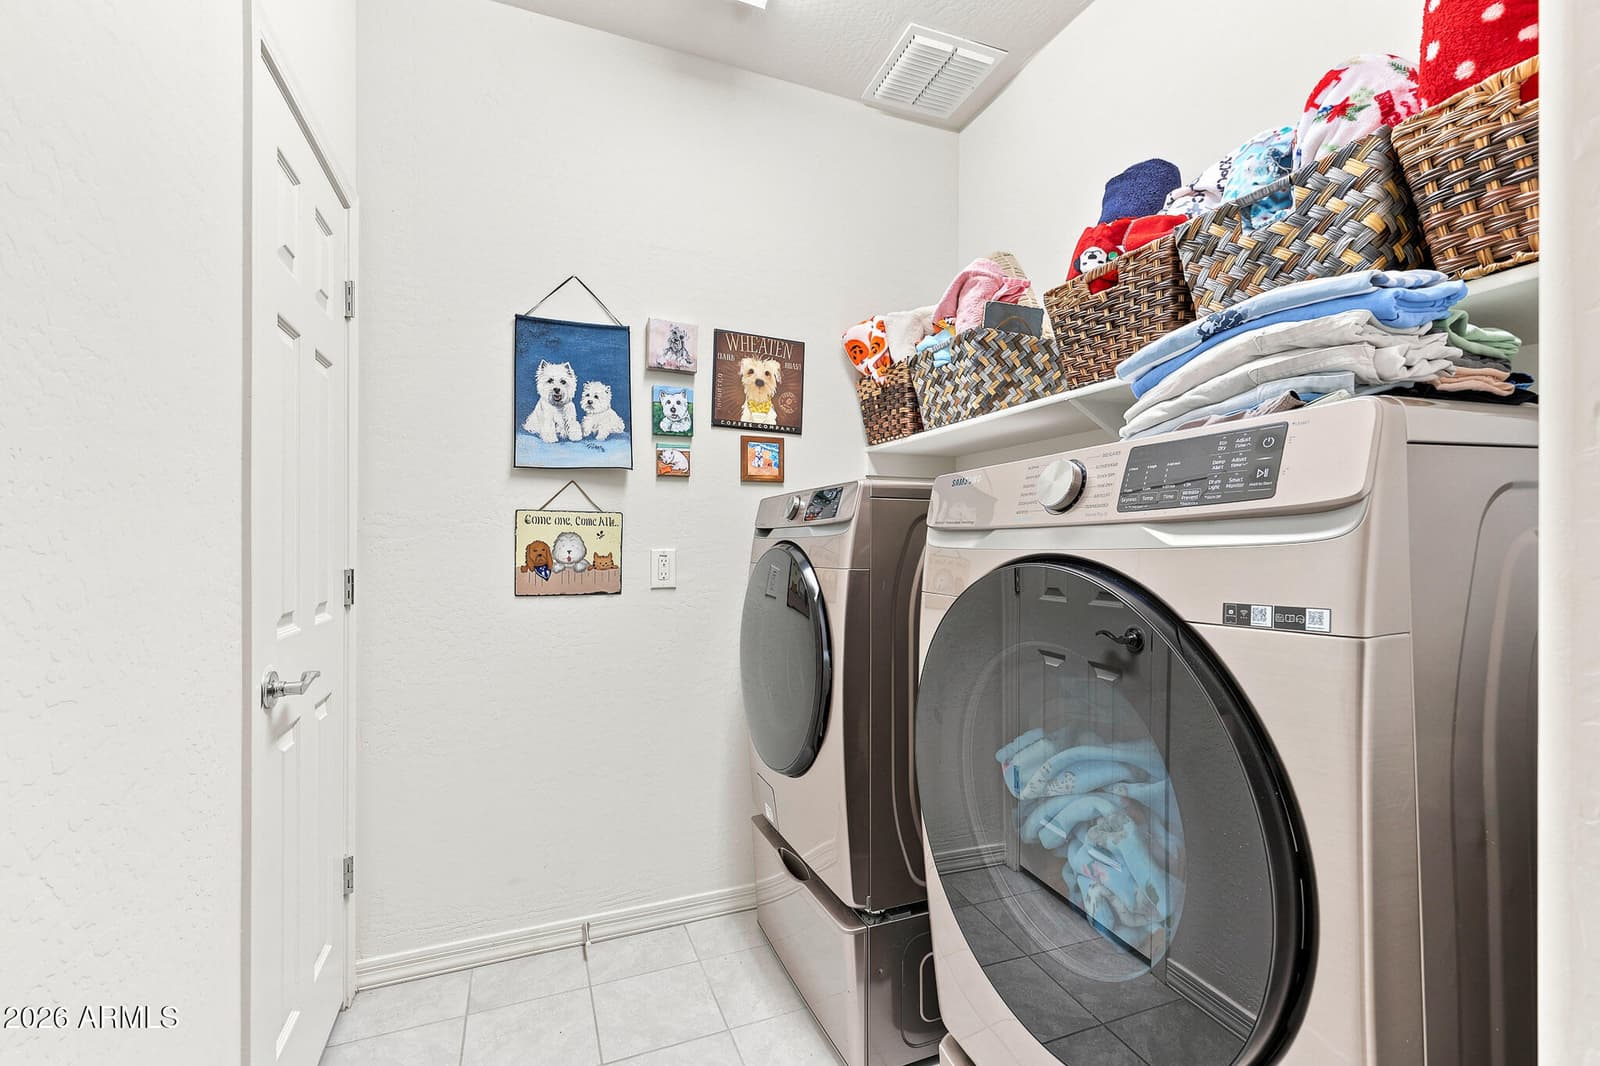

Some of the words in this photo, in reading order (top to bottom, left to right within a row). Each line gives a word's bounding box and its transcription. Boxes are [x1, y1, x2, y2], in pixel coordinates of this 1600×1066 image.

[725, 332, 794, 360] WHEATEN
[720, 419, 752, 428] COFFEE
[757, 424, 796, 432] COMPANY
[524, 514, 552, 525] Come
[554, 516, 573, 527] one,
[575, 516, 597, 527] Come
